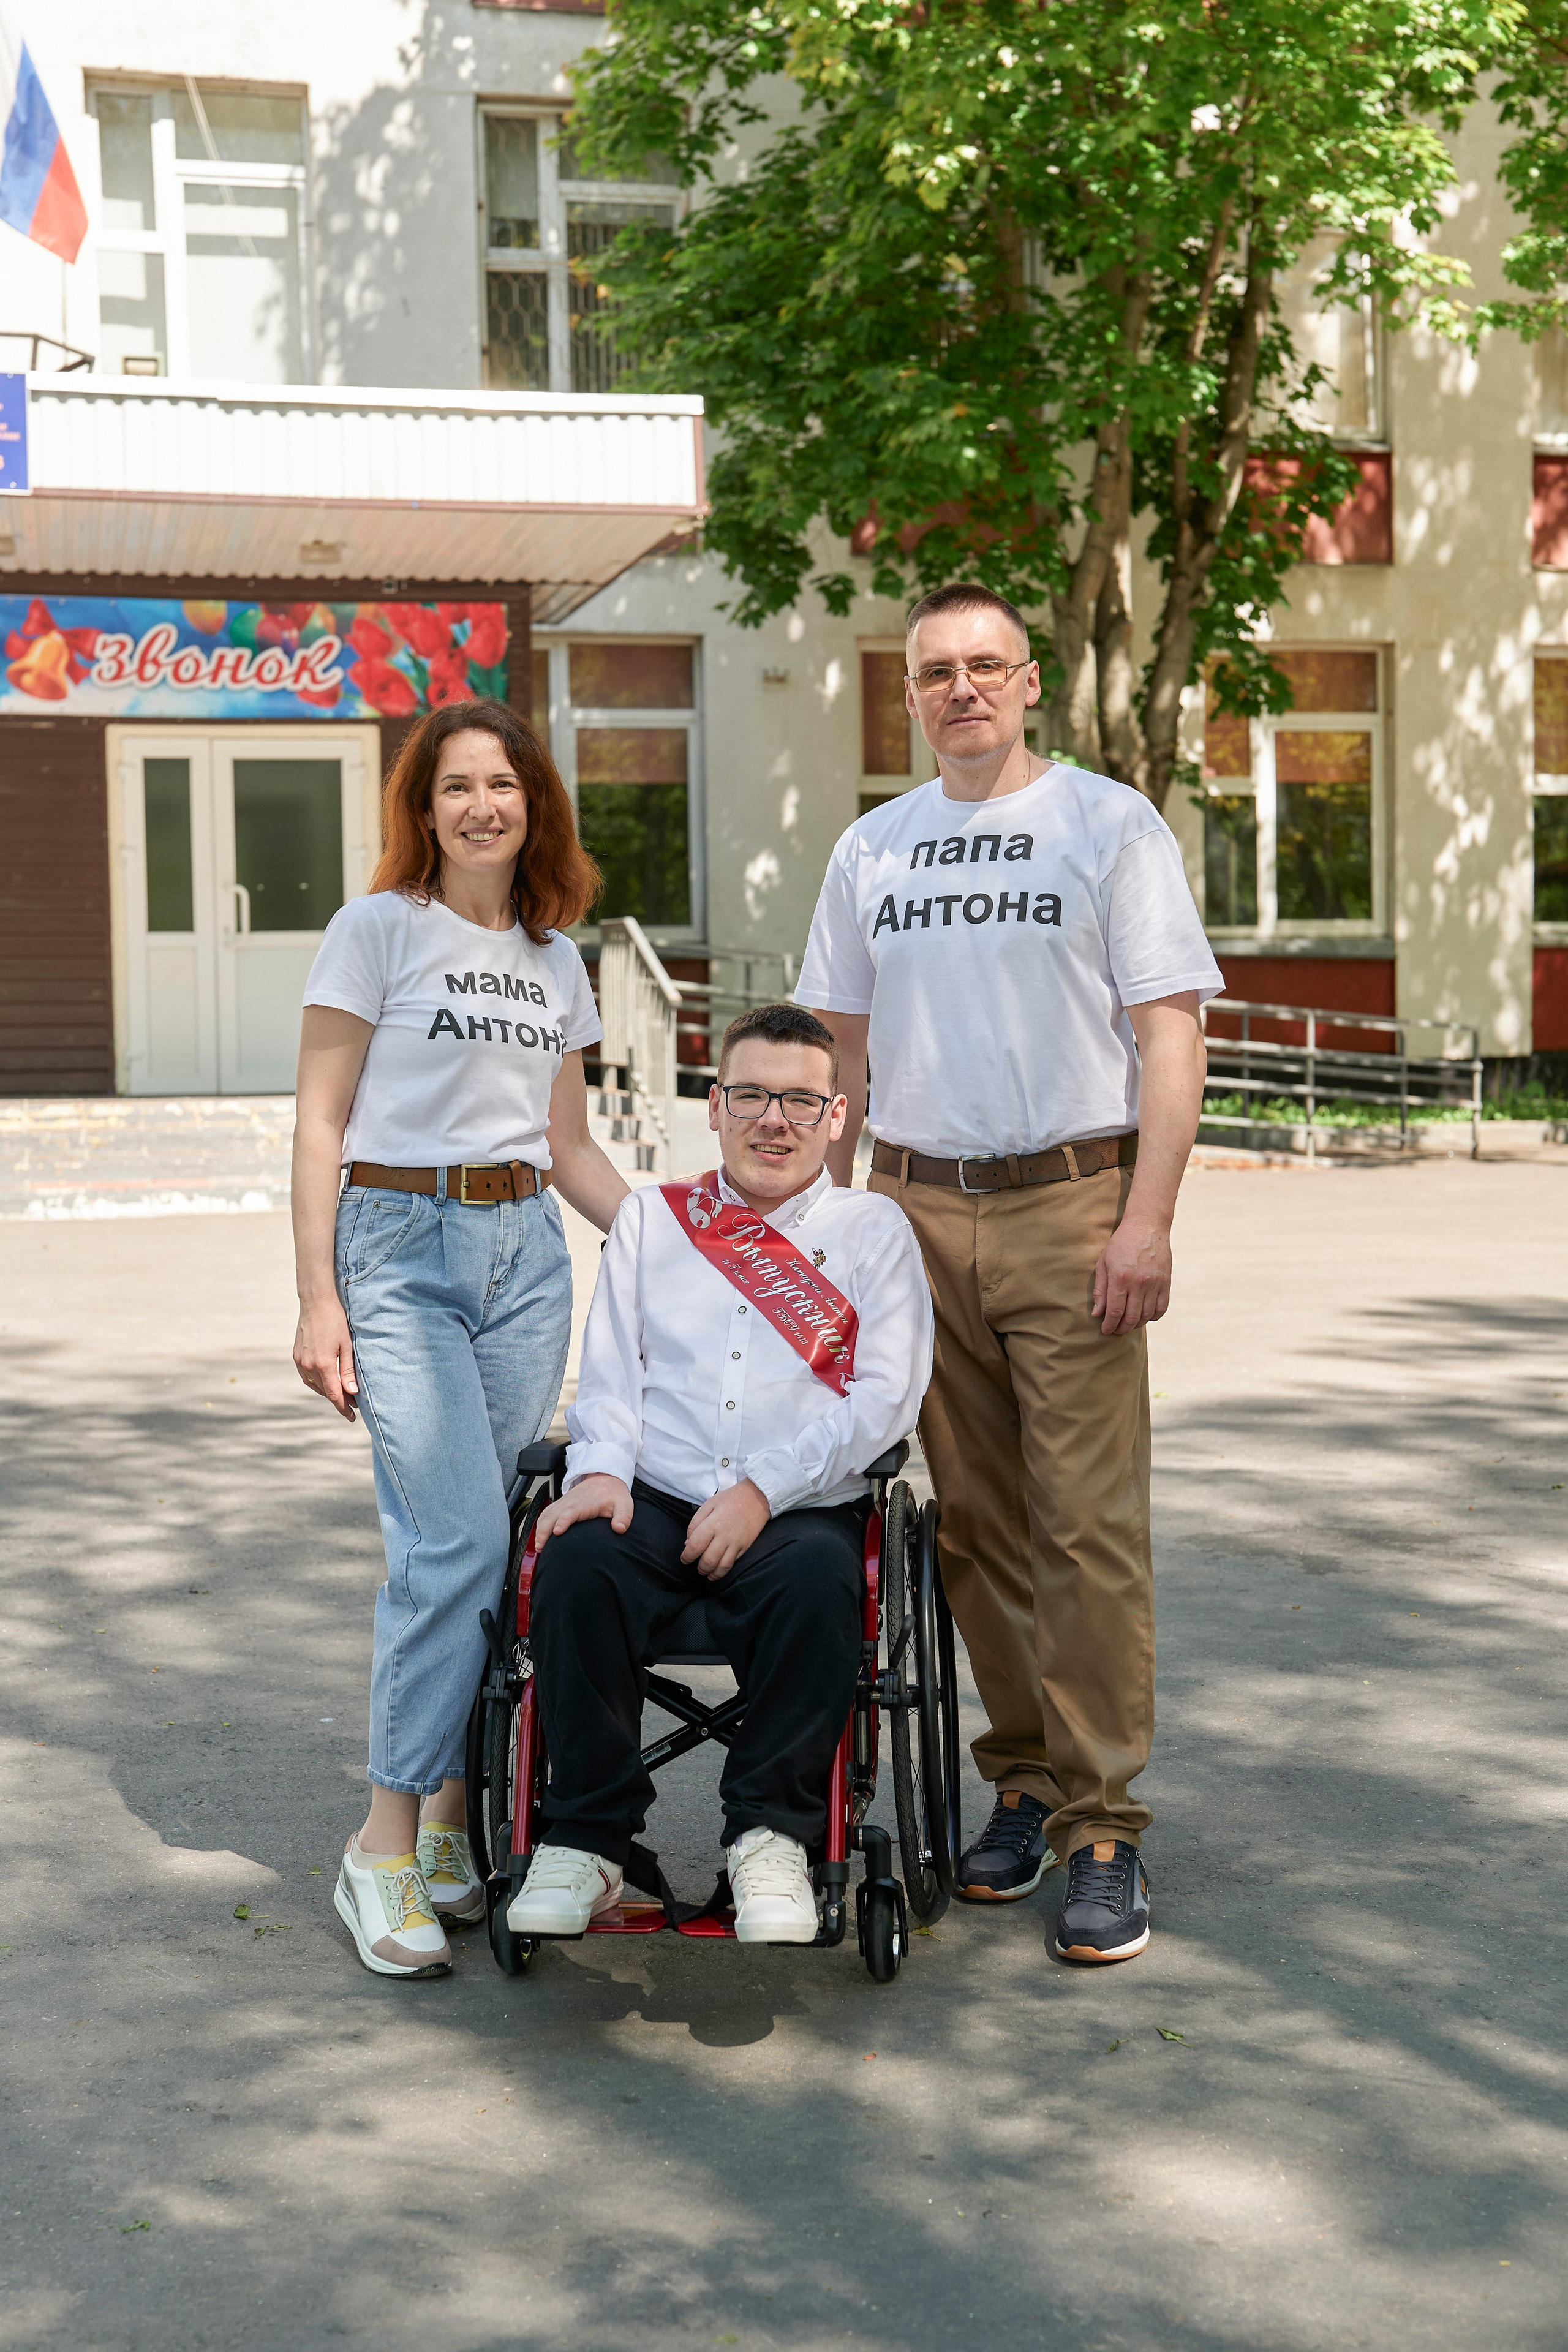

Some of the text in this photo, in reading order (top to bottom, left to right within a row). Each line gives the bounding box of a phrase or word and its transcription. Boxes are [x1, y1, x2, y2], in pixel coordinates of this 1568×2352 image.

[910, 833, 1034, 870] папа
[872, 892, 1061, 940] Антона
[445, 971, 548, 1008] мама
[717, 1213, 850, 1364] Выпускник
[733, 1270, 750, 1285] класс
[772, 1306, 809, 1345] ГБОУ 1413
[821, 1294, 848, 1324] Антон
